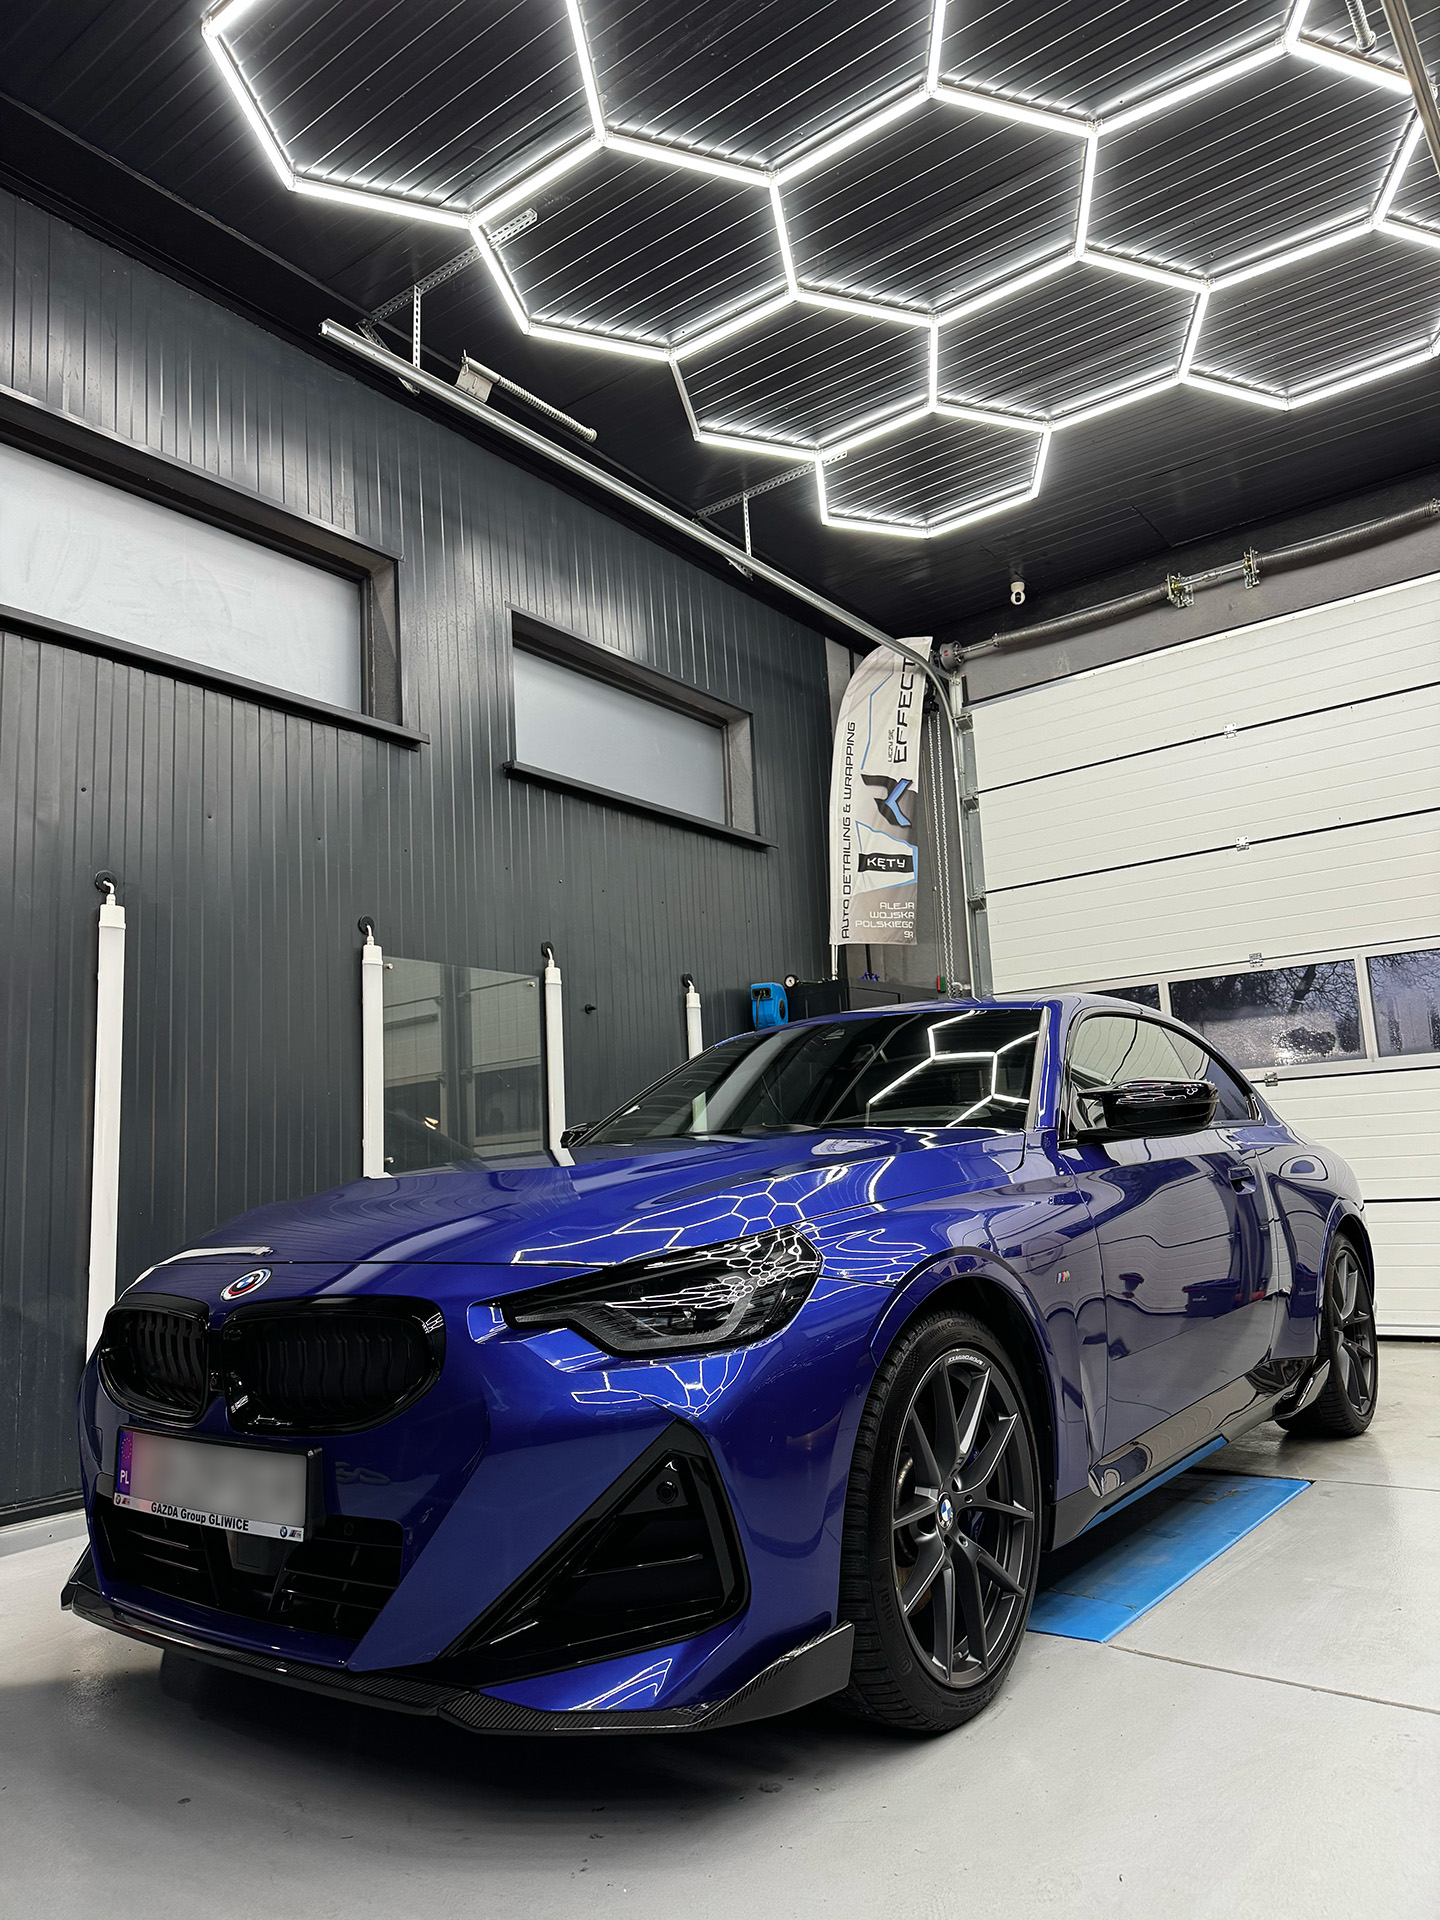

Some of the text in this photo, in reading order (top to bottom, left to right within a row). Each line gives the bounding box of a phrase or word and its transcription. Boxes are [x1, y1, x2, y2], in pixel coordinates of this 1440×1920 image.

[894, 657, 916, 763] EFFECT
[841, 721, 856, 939] AUTO DETAILING & WRAPPING
[866, 857, 906, 870] KĘTY
[879, 902, 915, 910] ALEJA
[869, 911, 915, 919] WOJSKA
[855, 920, 914, 928] POLSKIEGO
[119, 1469, 130, 1485] PL
[151, 1502, 249, 1531] GAZDA Group GLIWICE
